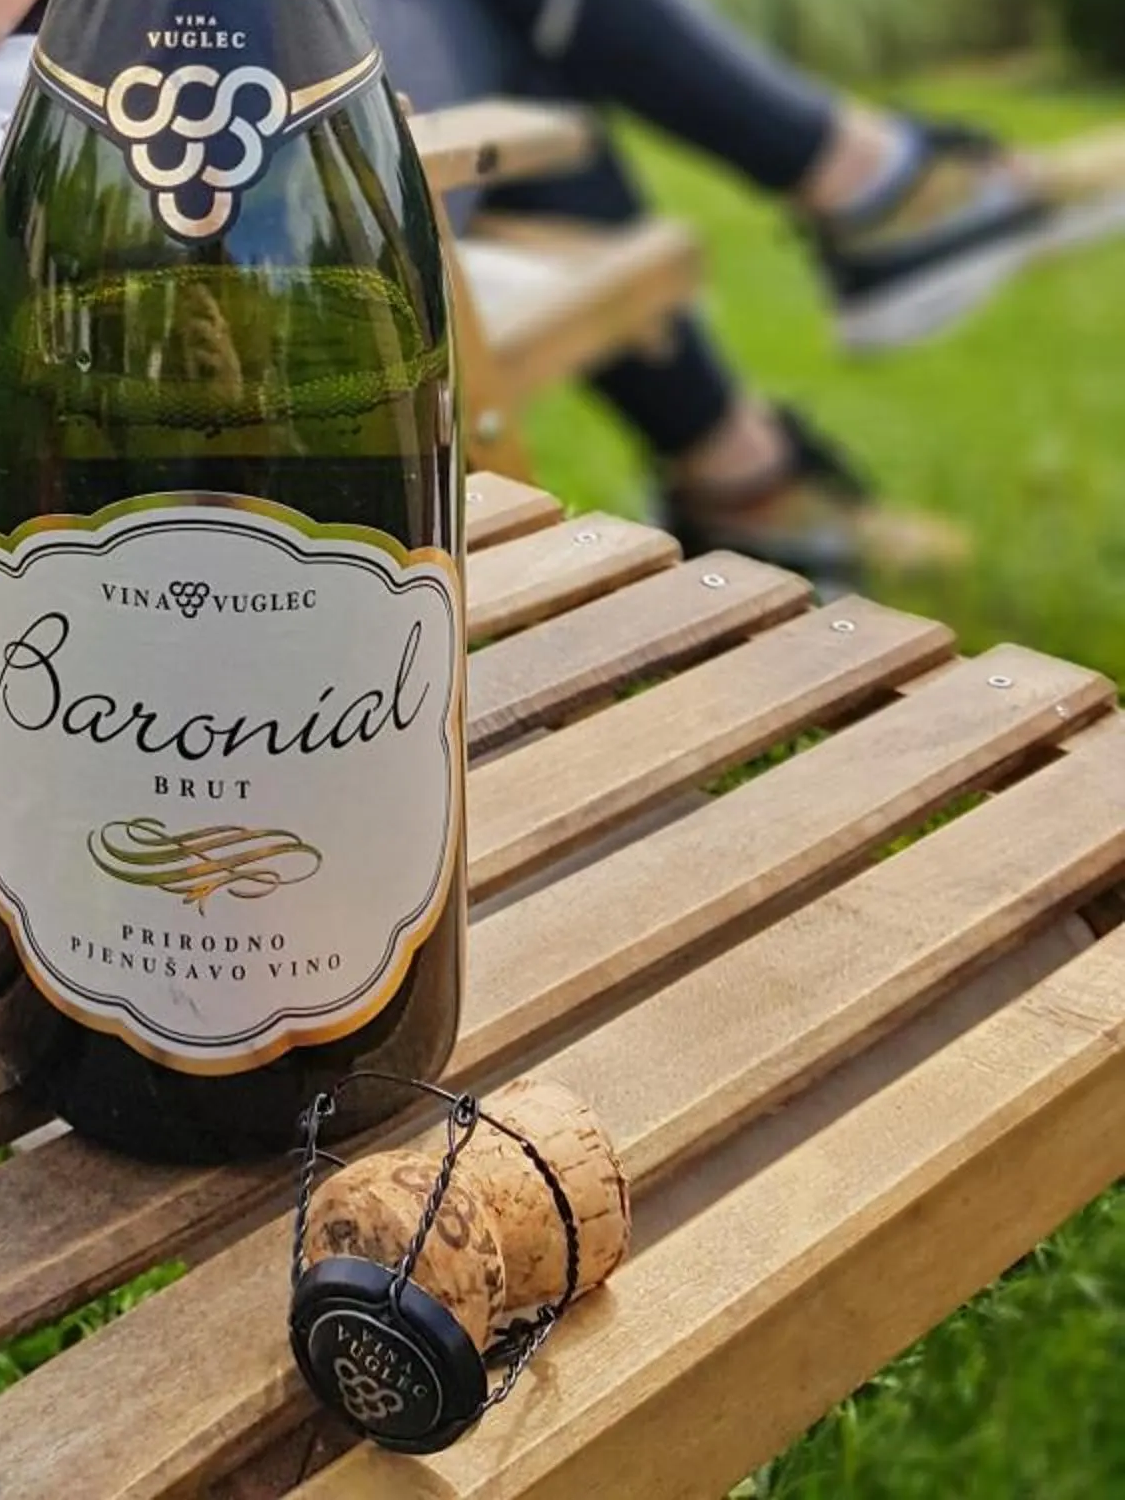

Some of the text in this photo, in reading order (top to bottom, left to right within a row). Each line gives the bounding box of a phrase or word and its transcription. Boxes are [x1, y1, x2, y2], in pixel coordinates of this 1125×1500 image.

[175, 14, 216, 26] VINA
[147, 31, 246, 49] VUGLEC
[102, 583, 317, 613] VINA VUGLEC
[154, 775, 251, 800] BRUT
[122, 924, 285, 953] PRIRODNO
[71, 936, 341, 981] PJENUŠAVO VINO
